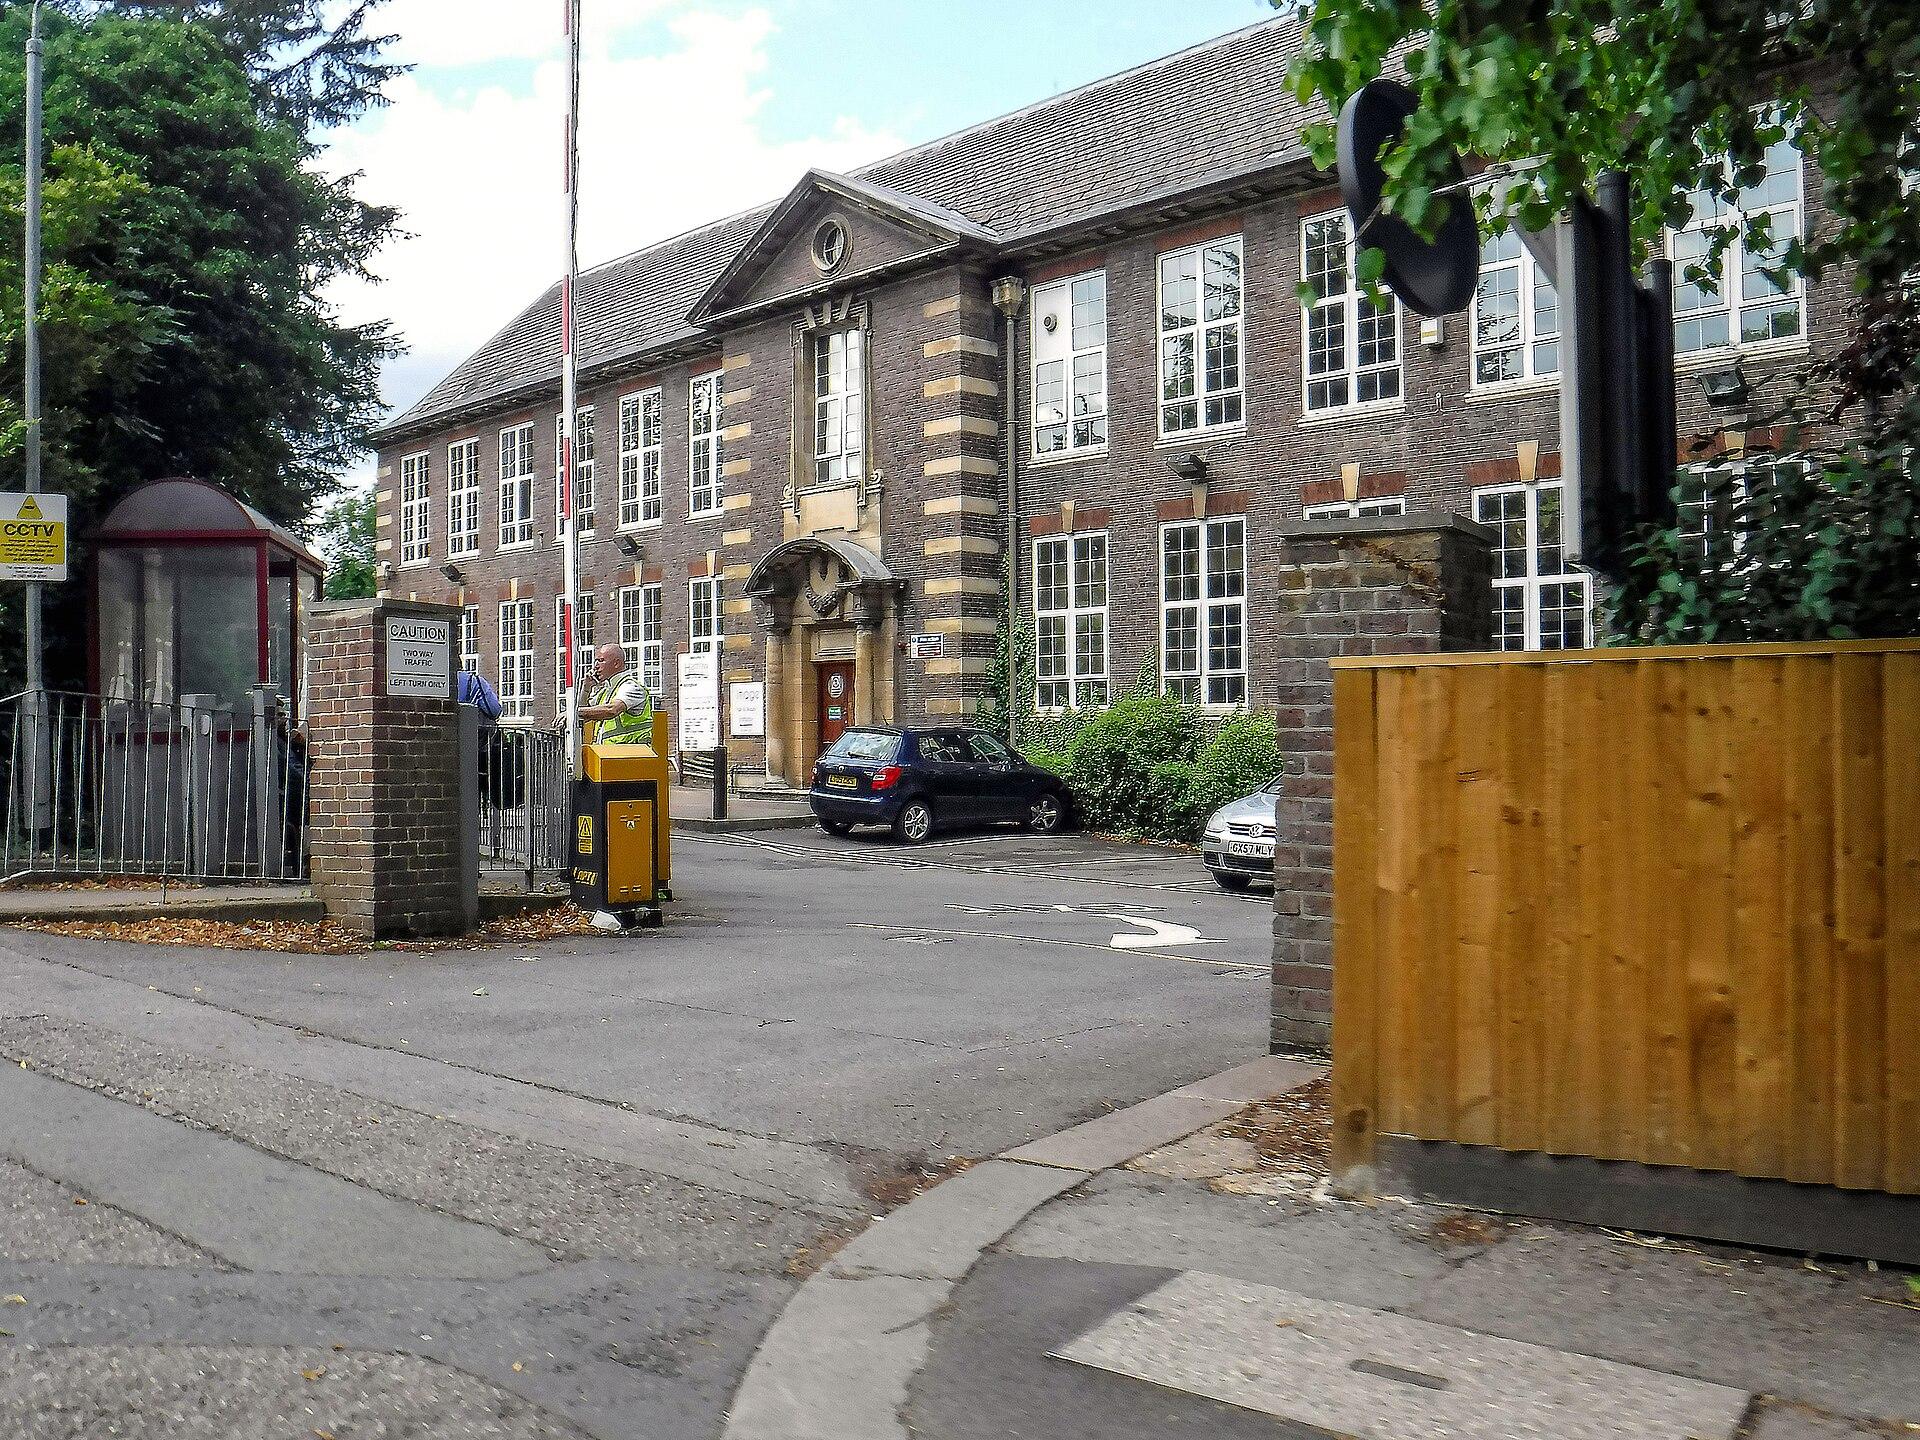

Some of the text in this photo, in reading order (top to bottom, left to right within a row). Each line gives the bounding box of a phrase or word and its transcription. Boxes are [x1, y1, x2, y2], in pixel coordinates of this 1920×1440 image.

[4, 523, 55, 536] CCTV
[390, 624, 446, 640] CAUTION
[402, 649, 434, 658] TWO WAY
[404, 658, 433, 667] TRAFFIC
[389, 679, 446, 689] LEFT TURN ONLY
[1232, 843, 1254, 853] GX57
